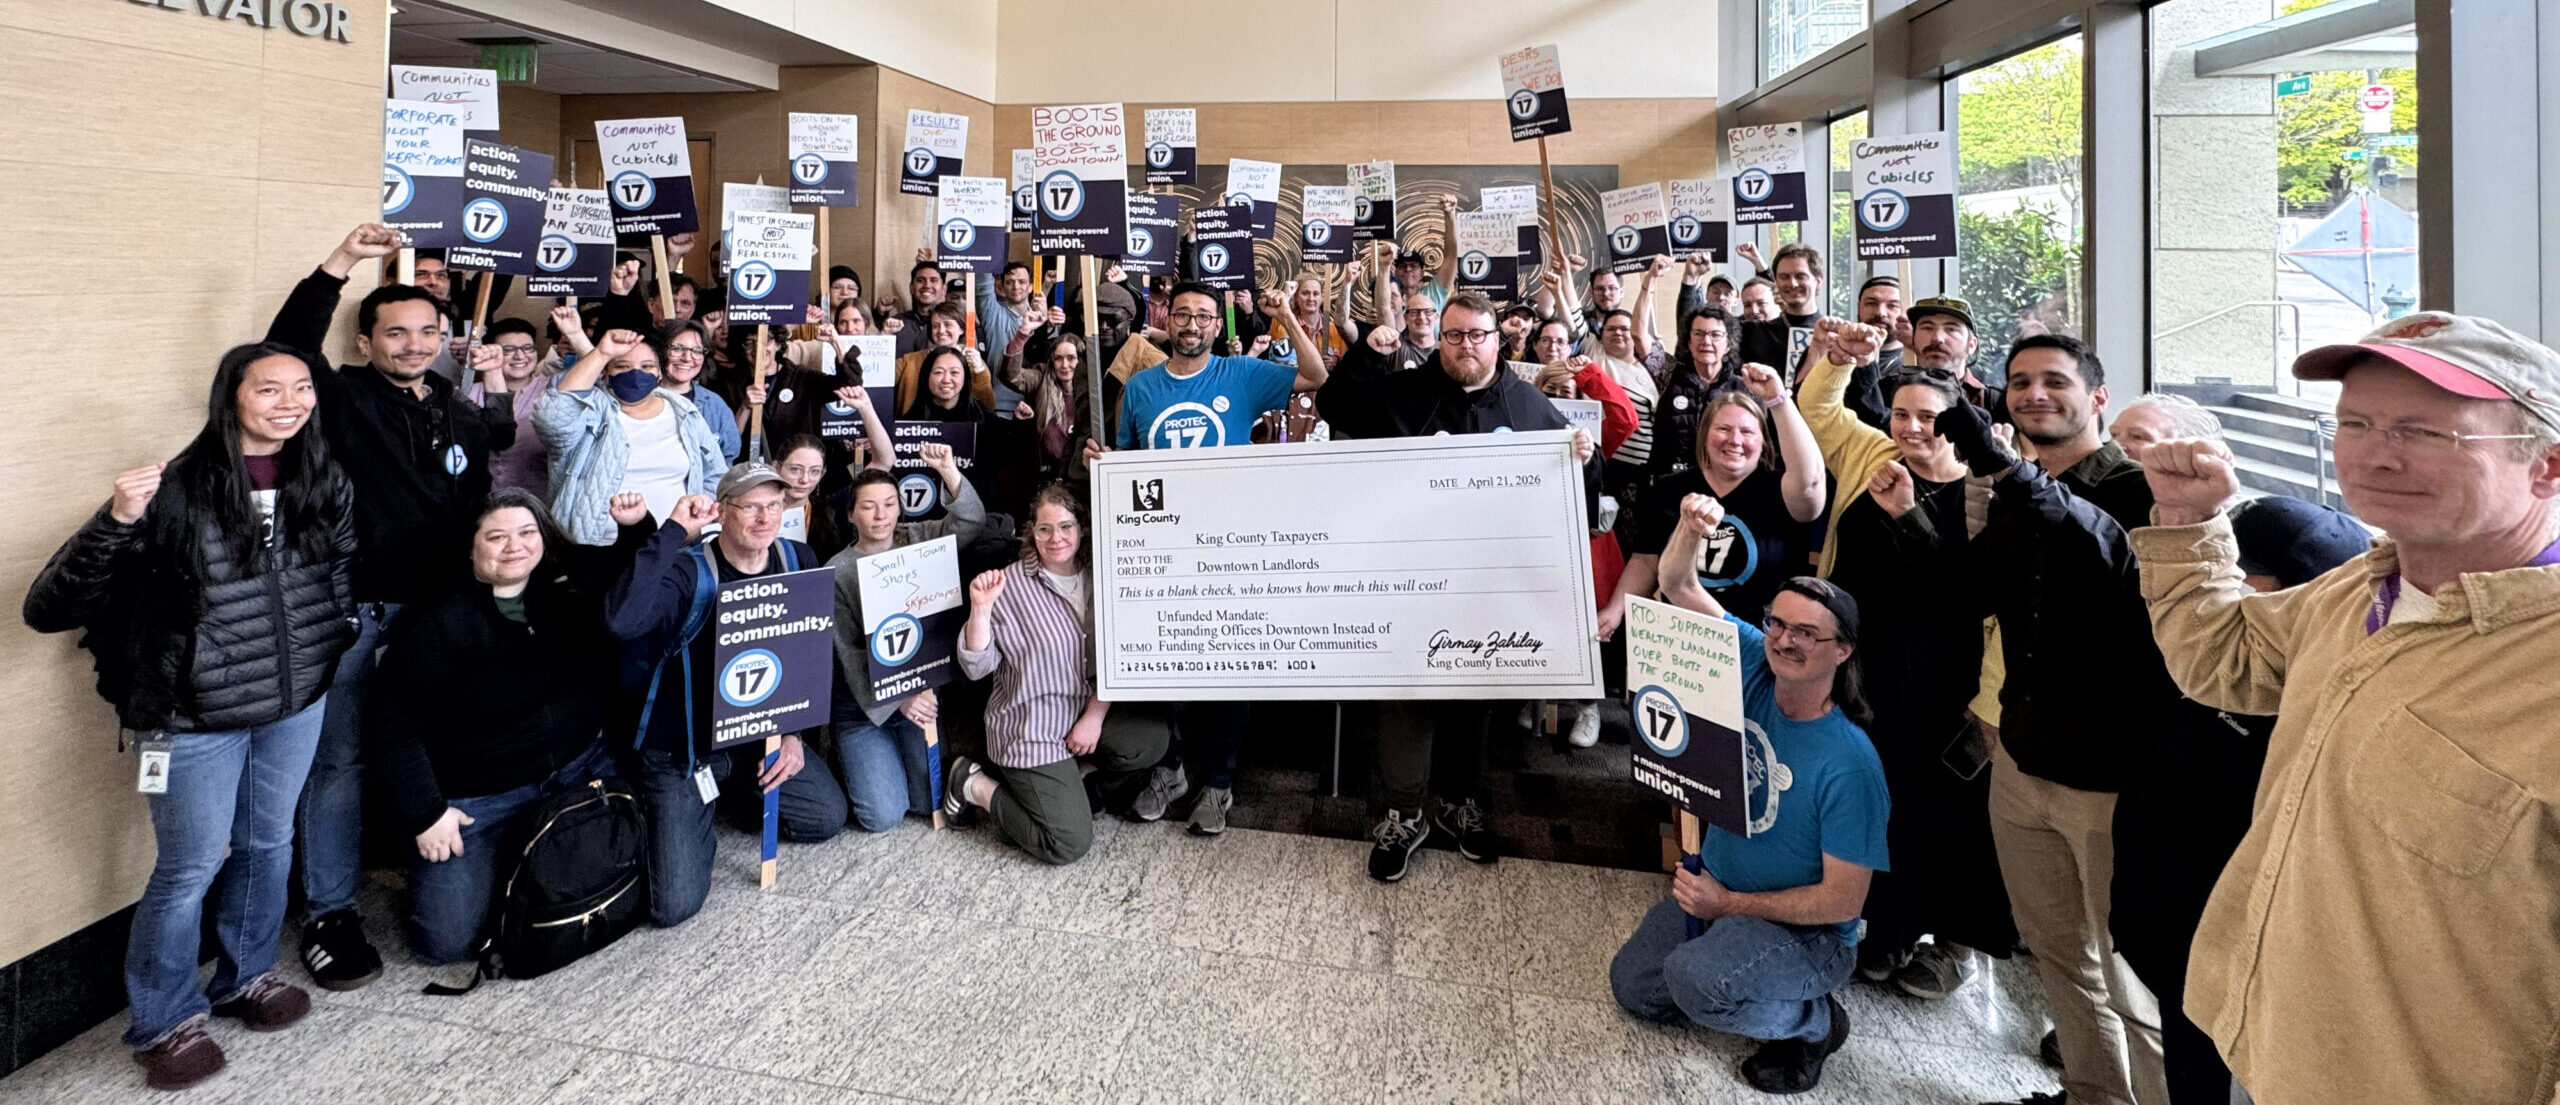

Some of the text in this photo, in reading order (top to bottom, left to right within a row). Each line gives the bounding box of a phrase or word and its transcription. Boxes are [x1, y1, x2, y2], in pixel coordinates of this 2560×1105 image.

[1502, 48, 1540, 69] DESKS
[401, 71, 490, 88] Communities
[424, 91, 472, 101] NOT
[1517, 98, 1533, 114] 17
[912, 114, 960, 129] RESULTS
[1034, 107, 1118, 127] BOOTS
[603, 124, 676, 138] Communities
[1035, 124, 1122, 144] THE GROUND
[395, 139, 431, 149] YOUR
[627, 141, 658, 151] NOT
[1035, 144, 1117, 158] BOOTS
[1856, 139, 1939, 159] Communities
[471, 145, 520, 163] action.
[468, 162, 518, 180] equity.
[465, 178, 548, 202] community.
[621, 184, 645, 202] 17
[1671, 181, 1711, 195] Really
[1744, 179, 1765, 195] 17
[577, 194, 610, 205] COUNT
[1050, 188, 1074, 211] 17
[1671, 195, 1715, 206] Terrible
[552, 204, 565, 212] IS
[1196, 209, 1228, 218] action.
[1871, 202, 1897, 222] 17
[737, 215, 776, 226] INVEST IN
[1624, 210, 1661, 224] DO YOU
[1737, 212, 1774, 221] union.
[617, 222, 660, 233] union.
[1197, 221, 1229, 230] equity.
[1678, 225, 1695, 238] 17
[1197, 229, 1252, 240] community.
[1311, 228, 1325, 240] 17
[1617, 234, 1634, 249] 17
[737, 239, 792, 249] COMMERCIAL
[1041, 237, 1085, 249] union.
[1132, 238, 1146, 251] 17
[1860, 243, 1910, 256] union.
[451, 252, 497, 268] union.
[737, 249, 799, 259] REAL ESTATE
[1207, 254, 1222, 267] 17
[939, 260, 973, 270] union.
[1467, 261, 1484, 275] 17
[529, 282, 574, 293] union.
[745, 274, 767, 291] 17
[729, 310, 771, 321] union.
[822, 425, 860, 436] union.
[895, 425, 942, 437] action.
[1165, 416, 1207, 431] PROTEC
[1429, 475, 1541, 490] DATE April 21, 2026
[904, 488, 927, 508] 17
[1116, 513, 1181, 527] King County
[1196, 531, 1329, 547] King County Taxpayers
[1710, 526, 1735, 538] OTEC
[1116, 539, 1145, 549] FROM
[872, 544, 947, 578] Small Town
[1117, 555, 1173, 565] PAY TO THE
[1197, 558, 1320, 573] Downtown Landlords
[1117, 566, 1168, 576] ORDER OF
[720, 581, 788, 604] action.
[1119, 579, 1448, 598] This is a blank check, who knows how much this will cost!
[720, 603, 788, 626] equity.
[1157, 610, 1269, 623] Unfunded Mandate:
[719, 614, 833, 647] community.
[882, 621, 911, 634] PROTEC
[1158, 622, 1393, 639] Expanding Offices Downtown Instead of
[1631, 603, 1735, 648] RTO: SUPPORTING
[883, 627, 912, 657] 17
[1120, 637, 1378, 654] MEMO Funding Services in Our Communities
[1427, 630, 1544, 658] Girmay Zahilay
[1631, 626, 1736, 667] WEALTHY LANDLORDS
[735, 658, 769, 671] PROTEC
[1287, 660, 1316, 670] 1001
[1427, 657, 1547, 670] King County Executive
[1633, 646, 1721, 679] OVER BOOTS ON
[874, 655, 950, 688] a member-powered
[1638, 662, 1705, 693] THE GROUND
[735, 667, 769, 696] 17
[875, 676, 926, 702] union.
[716, 699, 810, 727] a member-powered
[1645, 696, 1677, 715] PROTEC
[716, 718, 778, 742] union.
[1646, 706, 1676, 742] 17
[1633, 754, 1721, 800] a member-powered
[1634, 766, 1690, 805] union.
